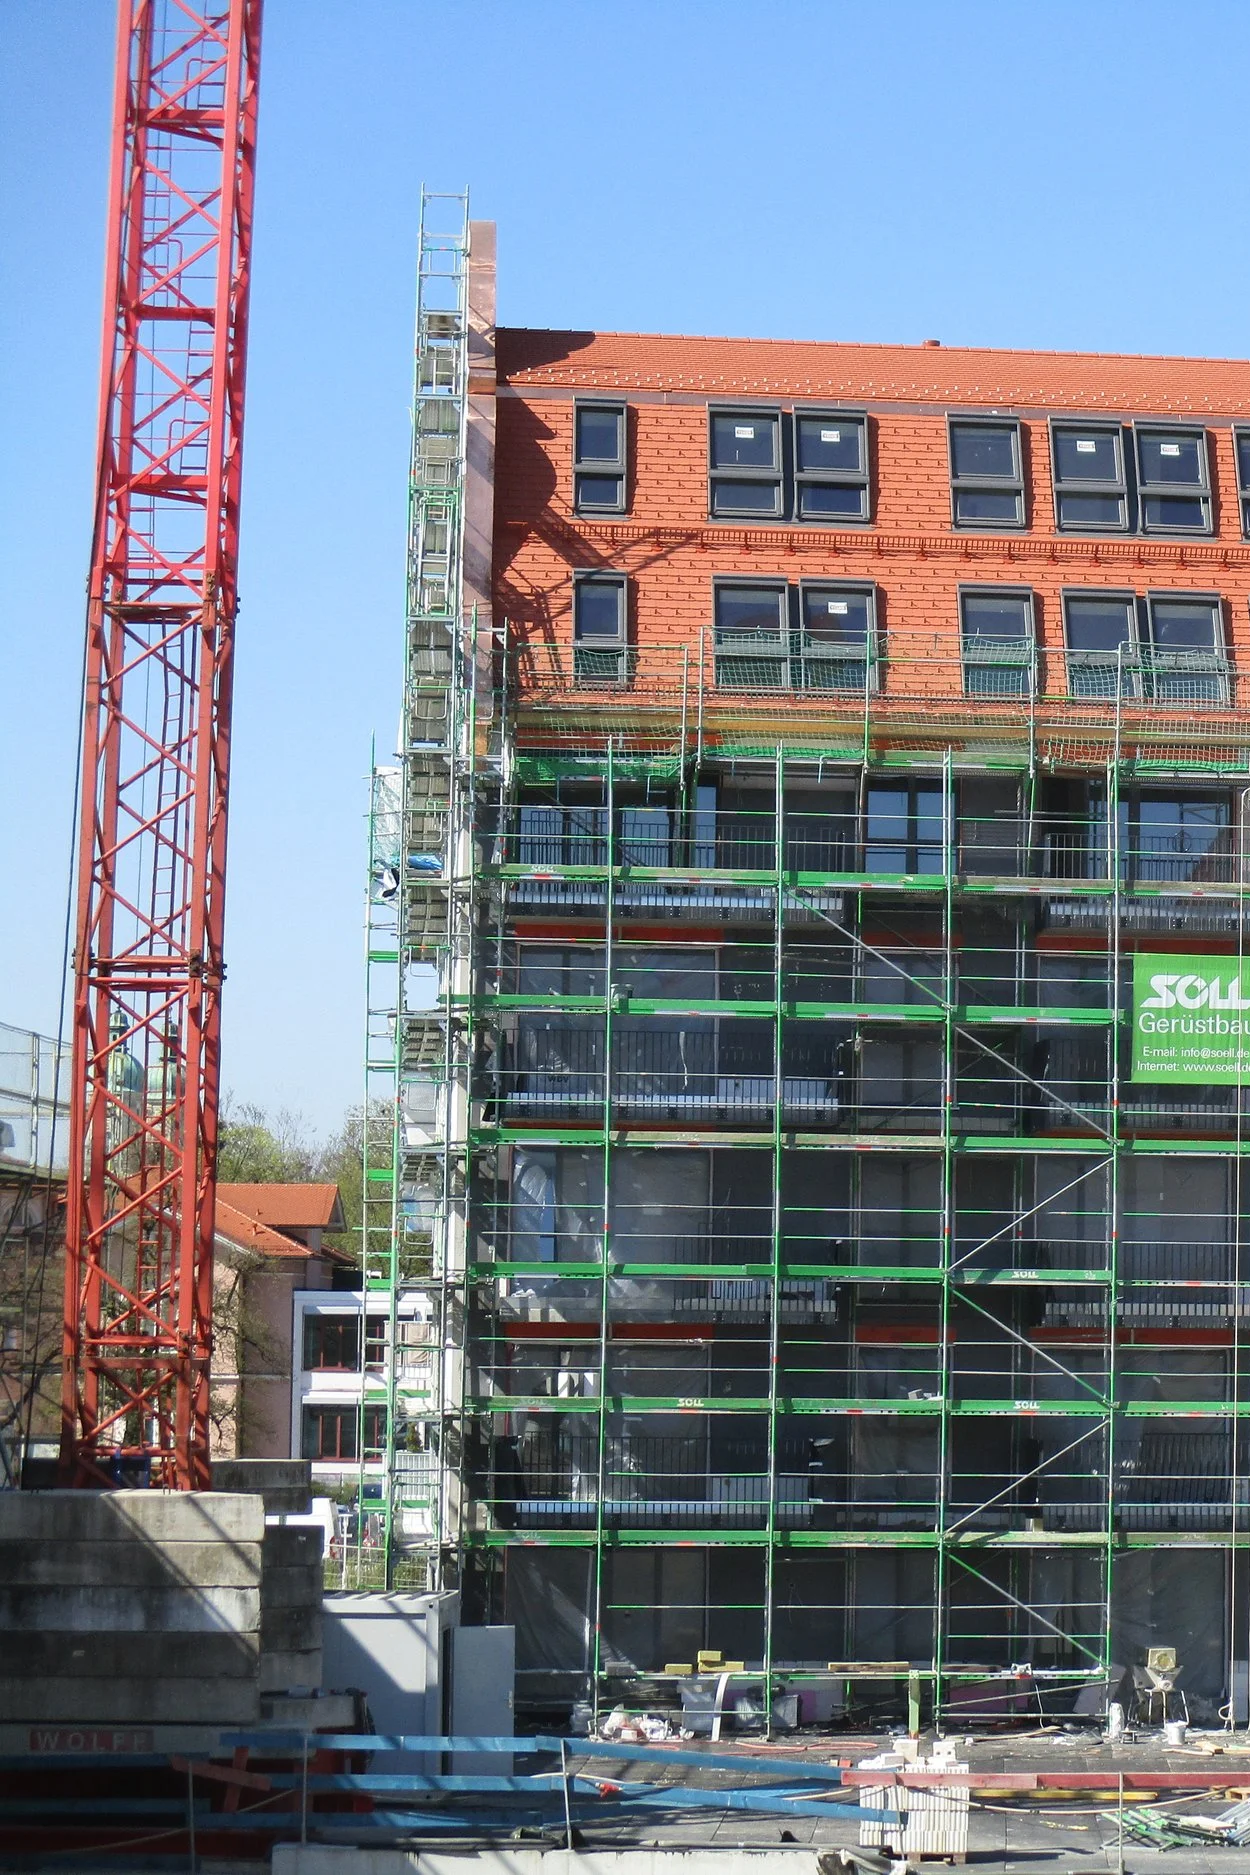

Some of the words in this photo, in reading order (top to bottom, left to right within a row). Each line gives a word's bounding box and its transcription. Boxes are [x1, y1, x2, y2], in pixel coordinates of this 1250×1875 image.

[1143, 1046, 1178, 1057] E-mail:
[1181, 1047, 1250, 1059] info@soell.de
[1137, 1061, 1180, 1071] Internet:
[37, 1731, 148, 1751] WOLFF
